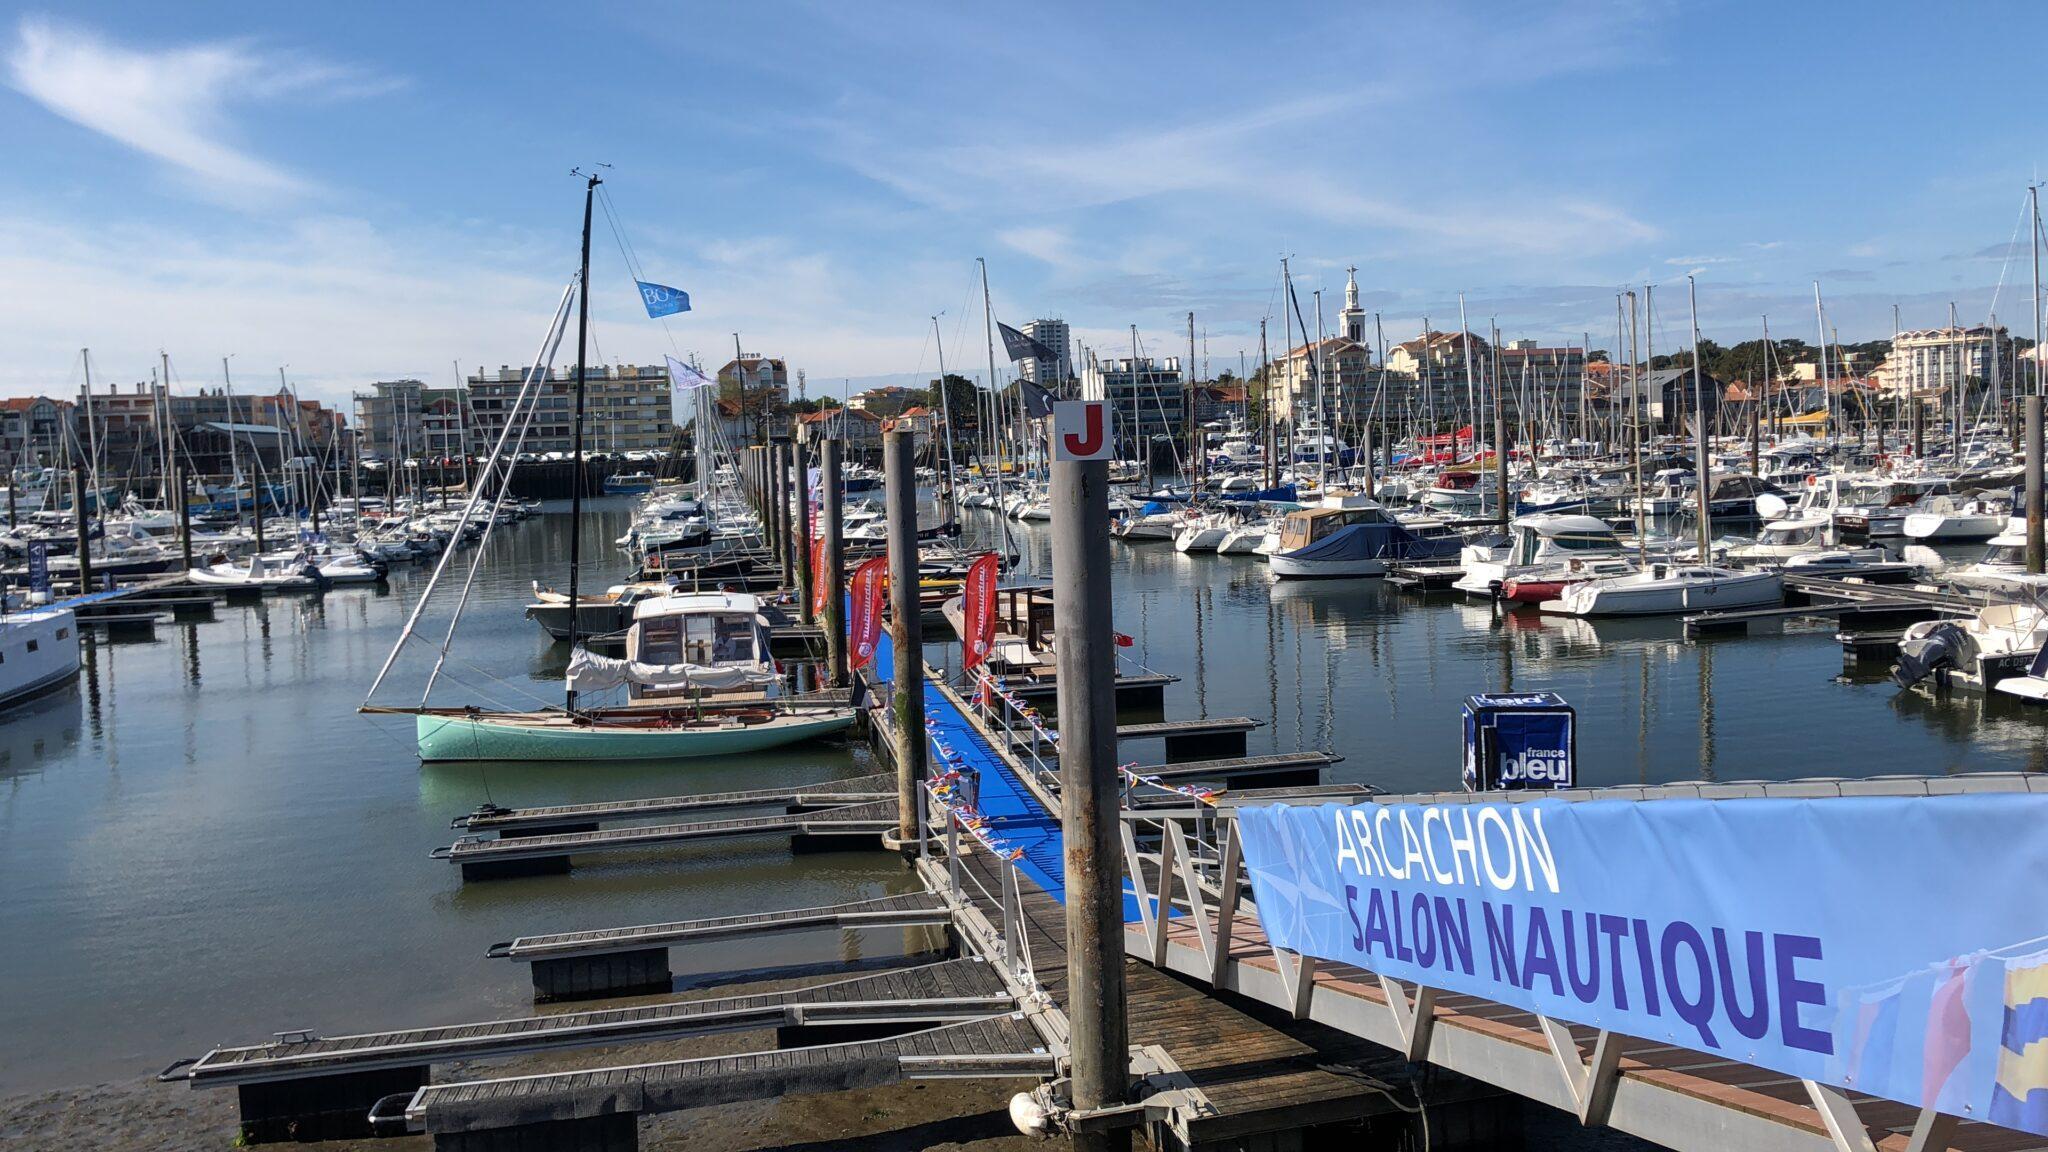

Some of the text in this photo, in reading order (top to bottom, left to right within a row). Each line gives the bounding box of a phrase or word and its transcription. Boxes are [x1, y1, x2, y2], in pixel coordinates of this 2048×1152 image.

[1064, 404, 1103, 456] J
[1500, 752, 1566, 781] bleu
[1527, 747, 1566, 758] france
[1335, 807, 1559, 893] ARCACHON
[1345, 885, 1834, 1055] SALON NAUTIQUE
